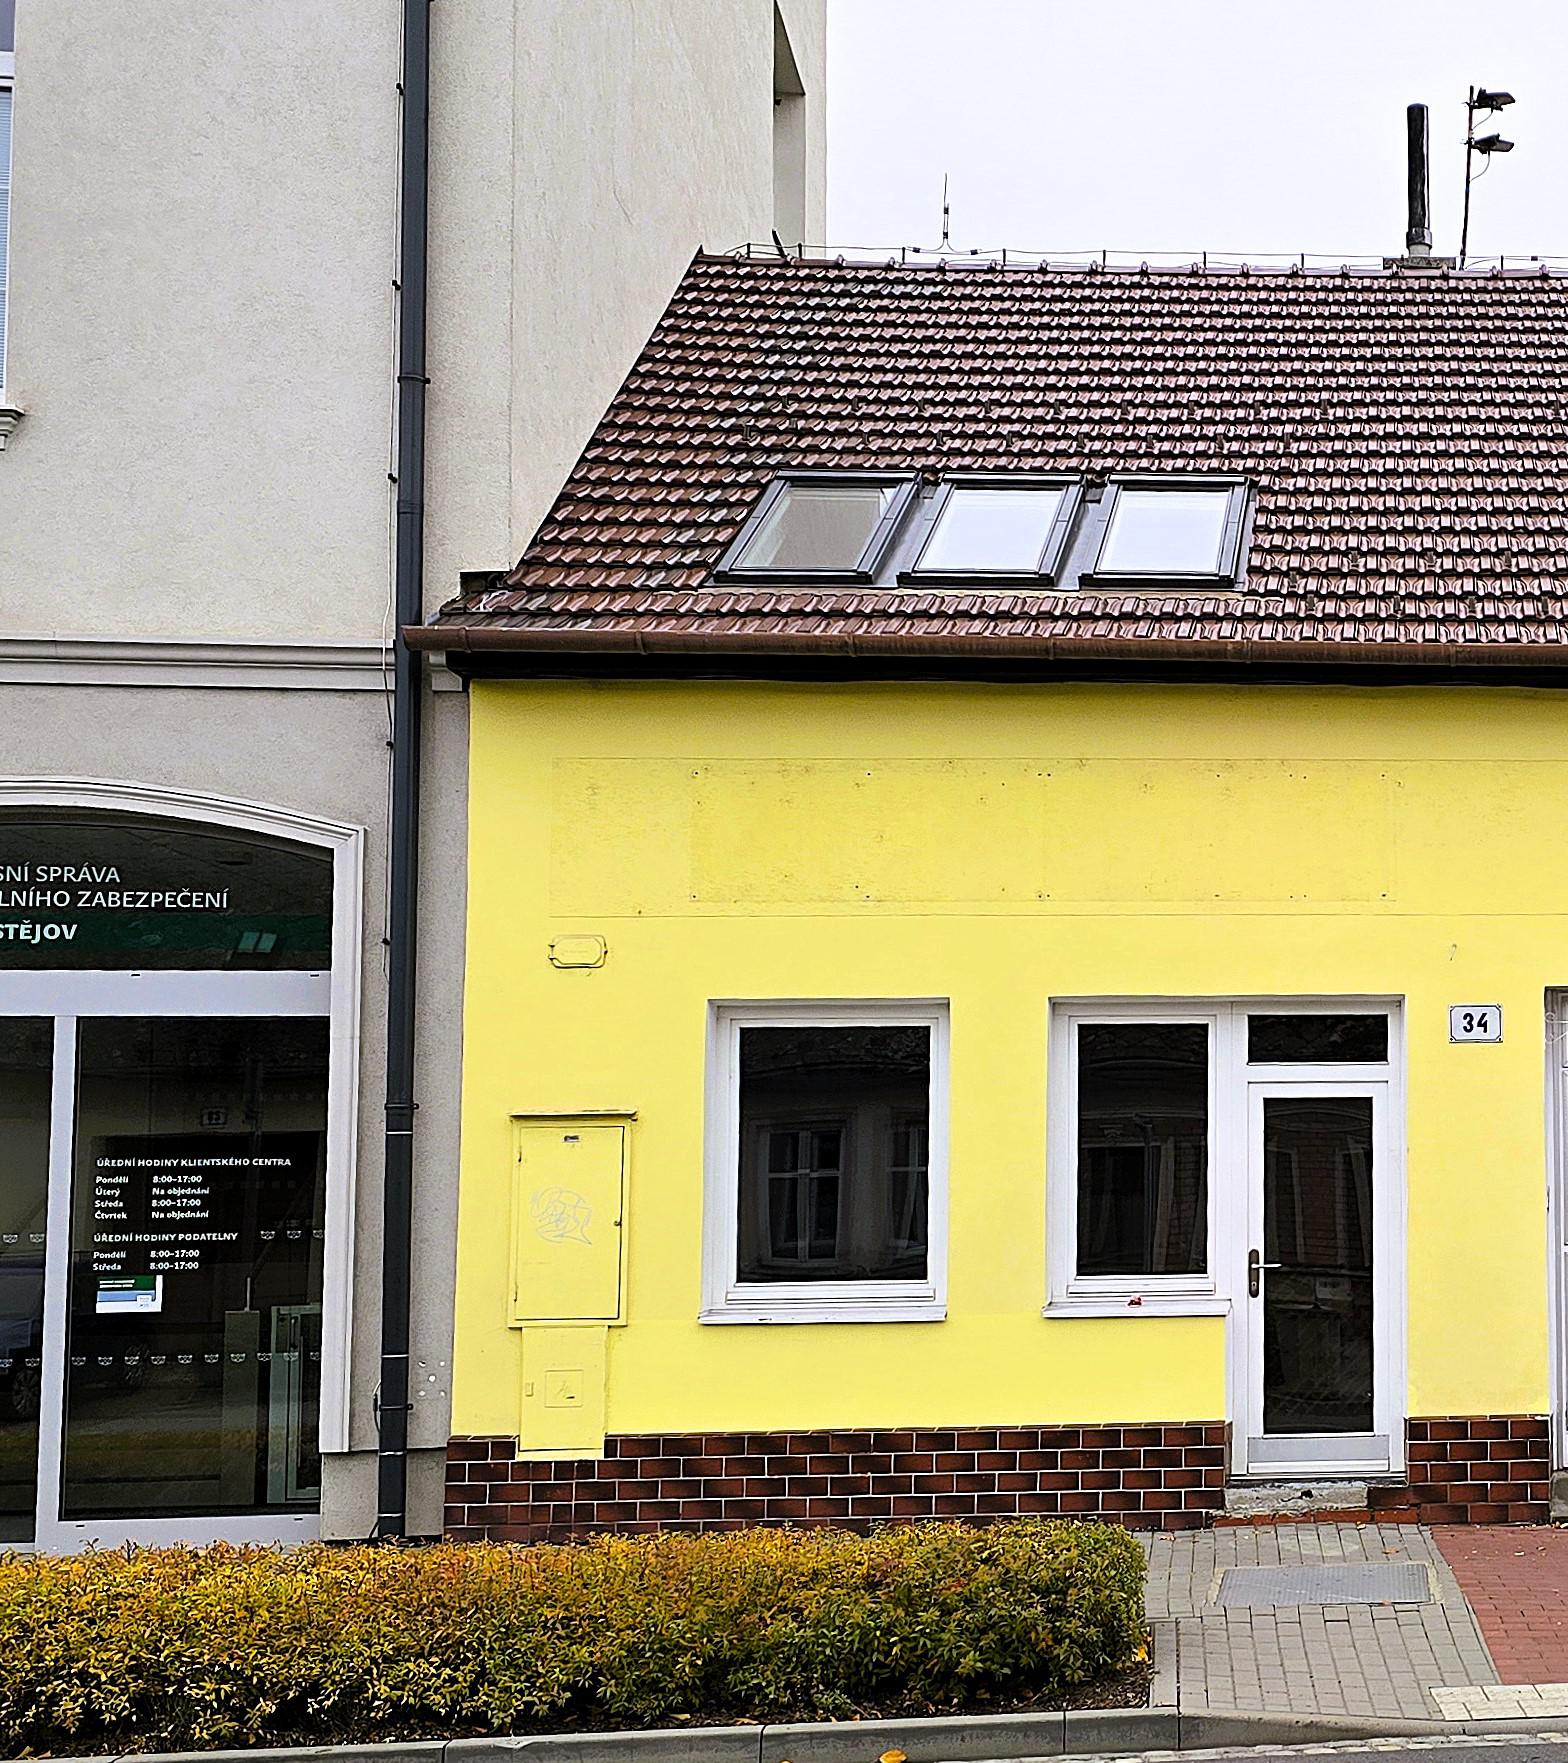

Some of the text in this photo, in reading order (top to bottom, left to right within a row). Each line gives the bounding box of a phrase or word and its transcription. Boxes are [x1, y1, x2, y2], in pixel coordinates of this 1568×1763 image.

[36, 863, 120, 882] SPRÁVA
[77, 888, 228, 908] ZABEZPEČENÍ
[1463, 1013, 1487, 1033] 34
[97, 1158, 135, 1166] ÚŘEDNÍ
[181, 1157, 249, 1166] KLIENTSKÉHO
[96, 1186, 120, 1197] Úterý
[167, 1187, 209, 1196] objednání
[95, 1210, 127, 1219] Čtvrtek
[167, 1210, 208, 1220] objednání
[94, 1233, 132, 1242] ÚŘEDNÍ
